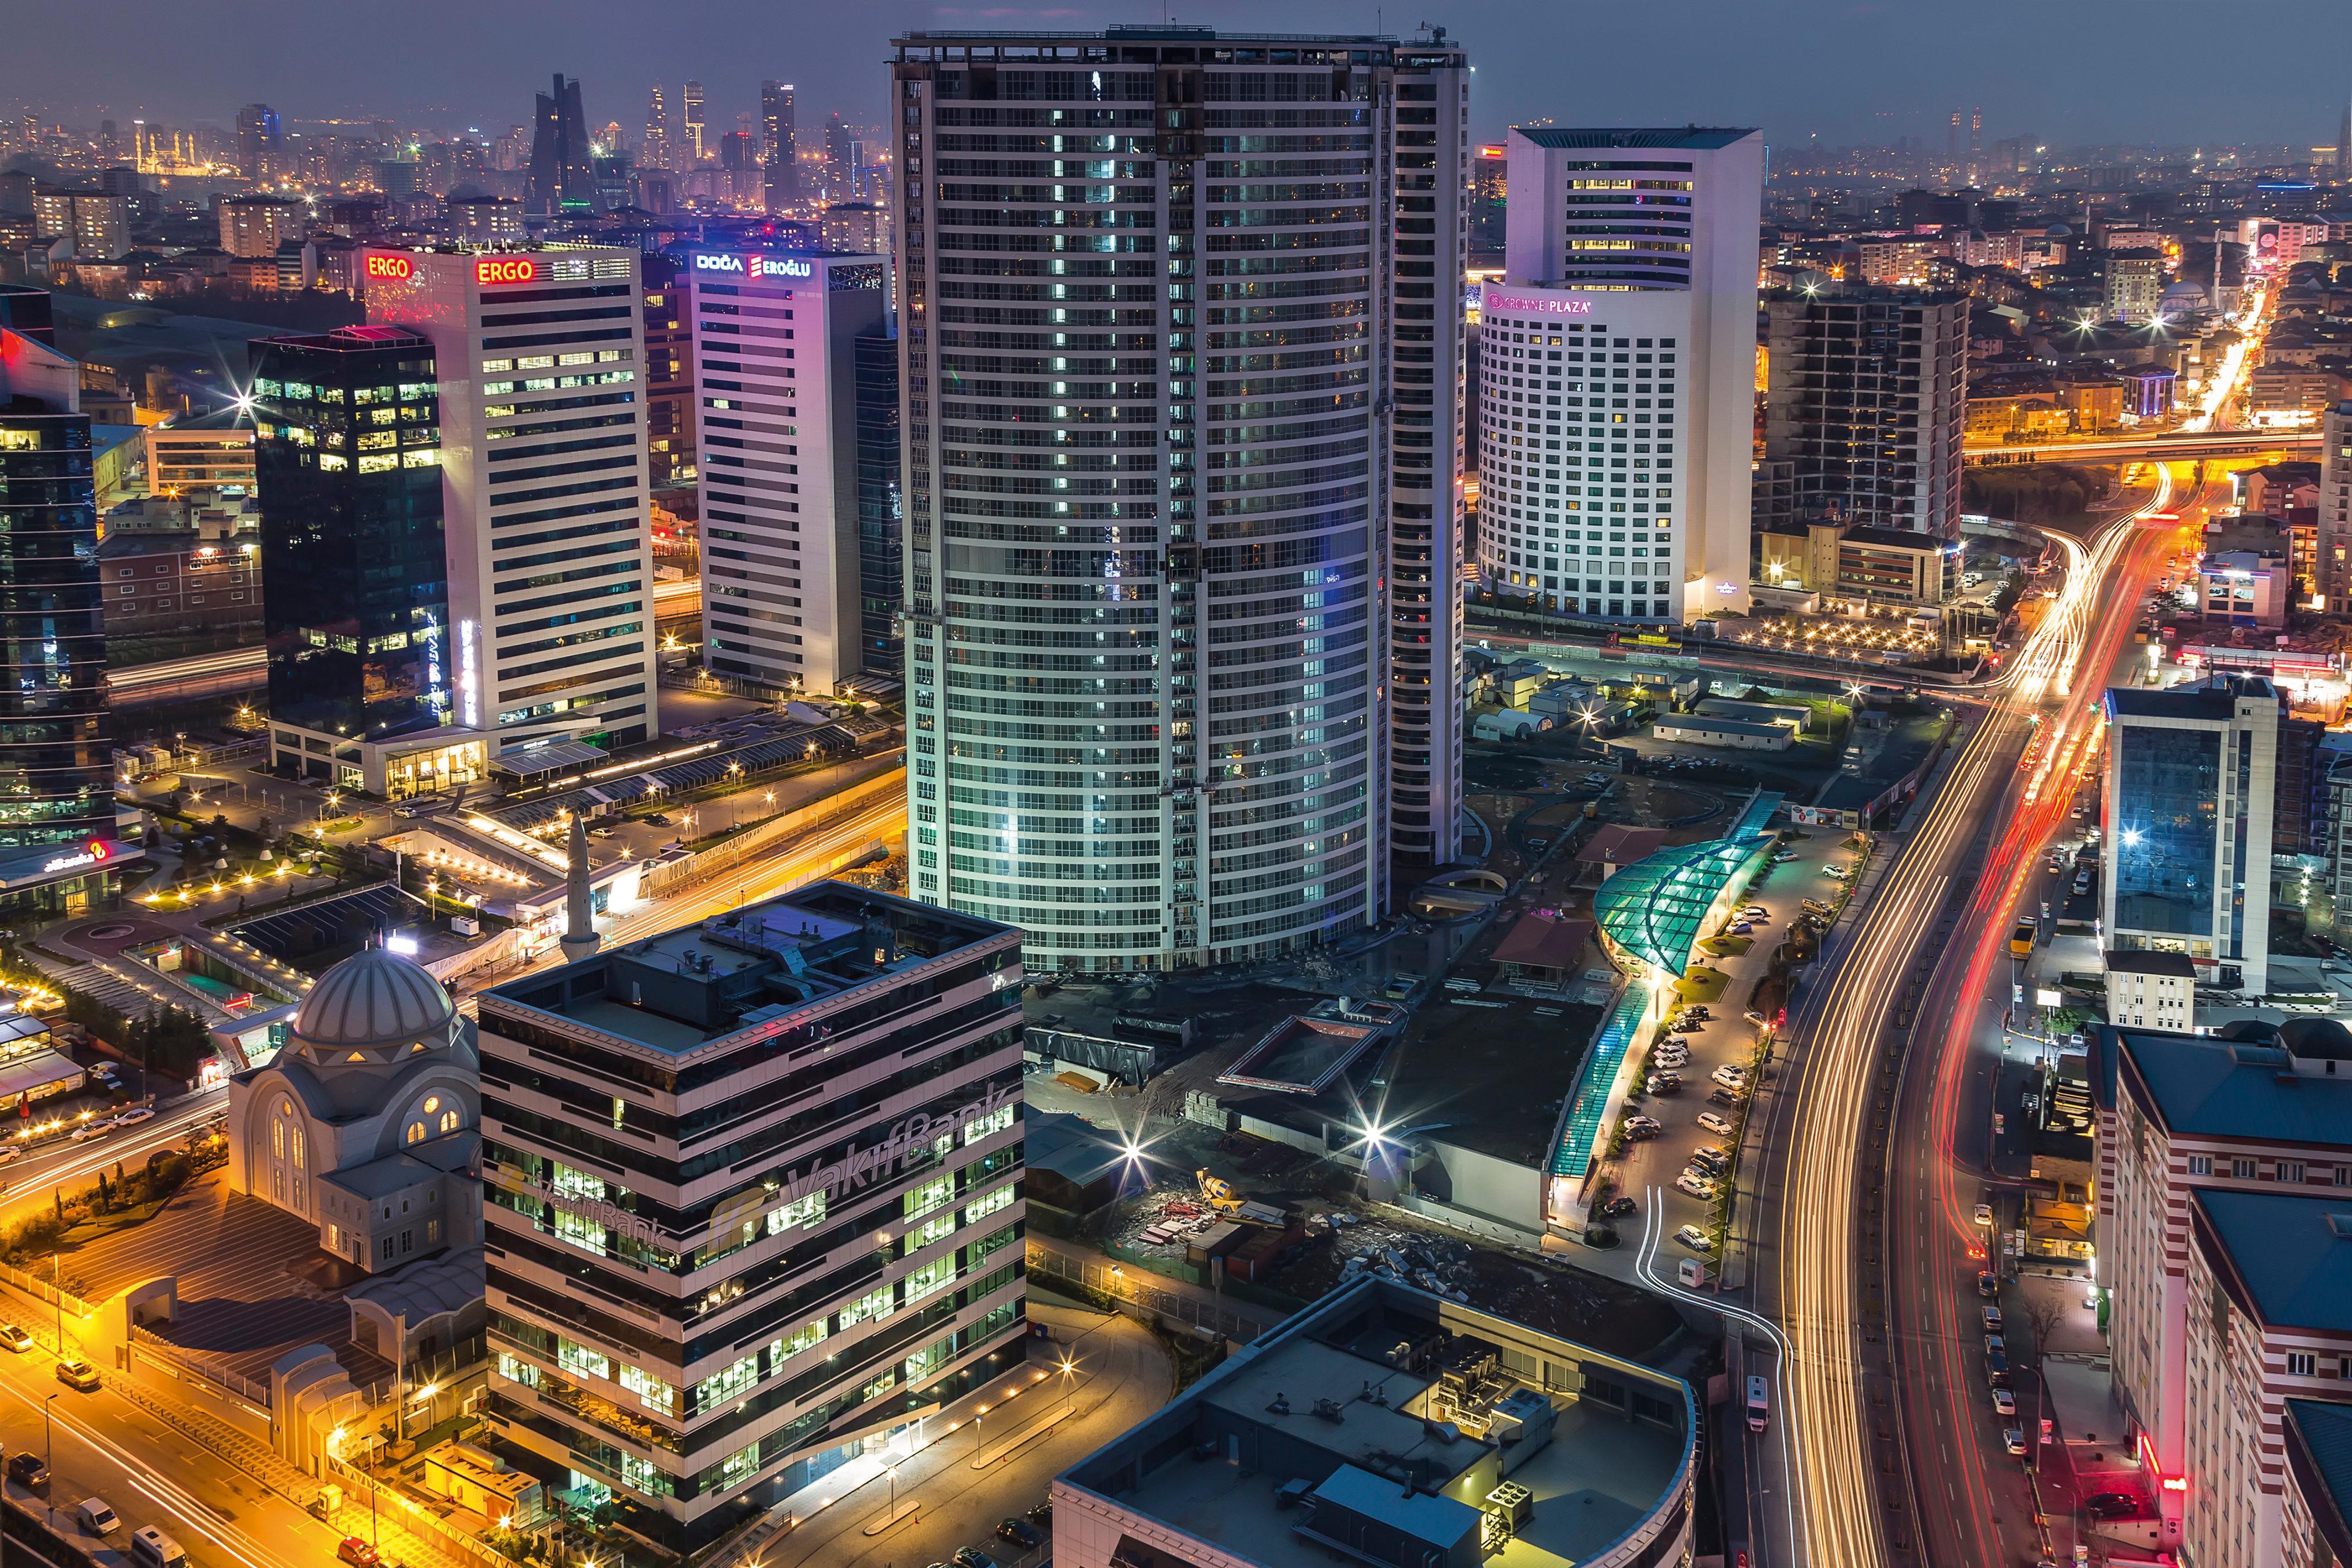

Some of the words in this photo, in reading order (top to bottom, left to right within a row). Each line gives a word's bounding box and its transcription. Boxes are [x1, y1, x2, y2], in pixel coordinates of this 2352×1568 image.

[368, 257, 408, 278] ERGO
[478, 261, 532, 282] ERGO
[696, 254, 743, 271] DOĞA
[763, 259, 811, 277] EROĞLU
[1505, 297, 1545, 311] CROWNE
[1549, 301, 1589, 313] PLAZA
